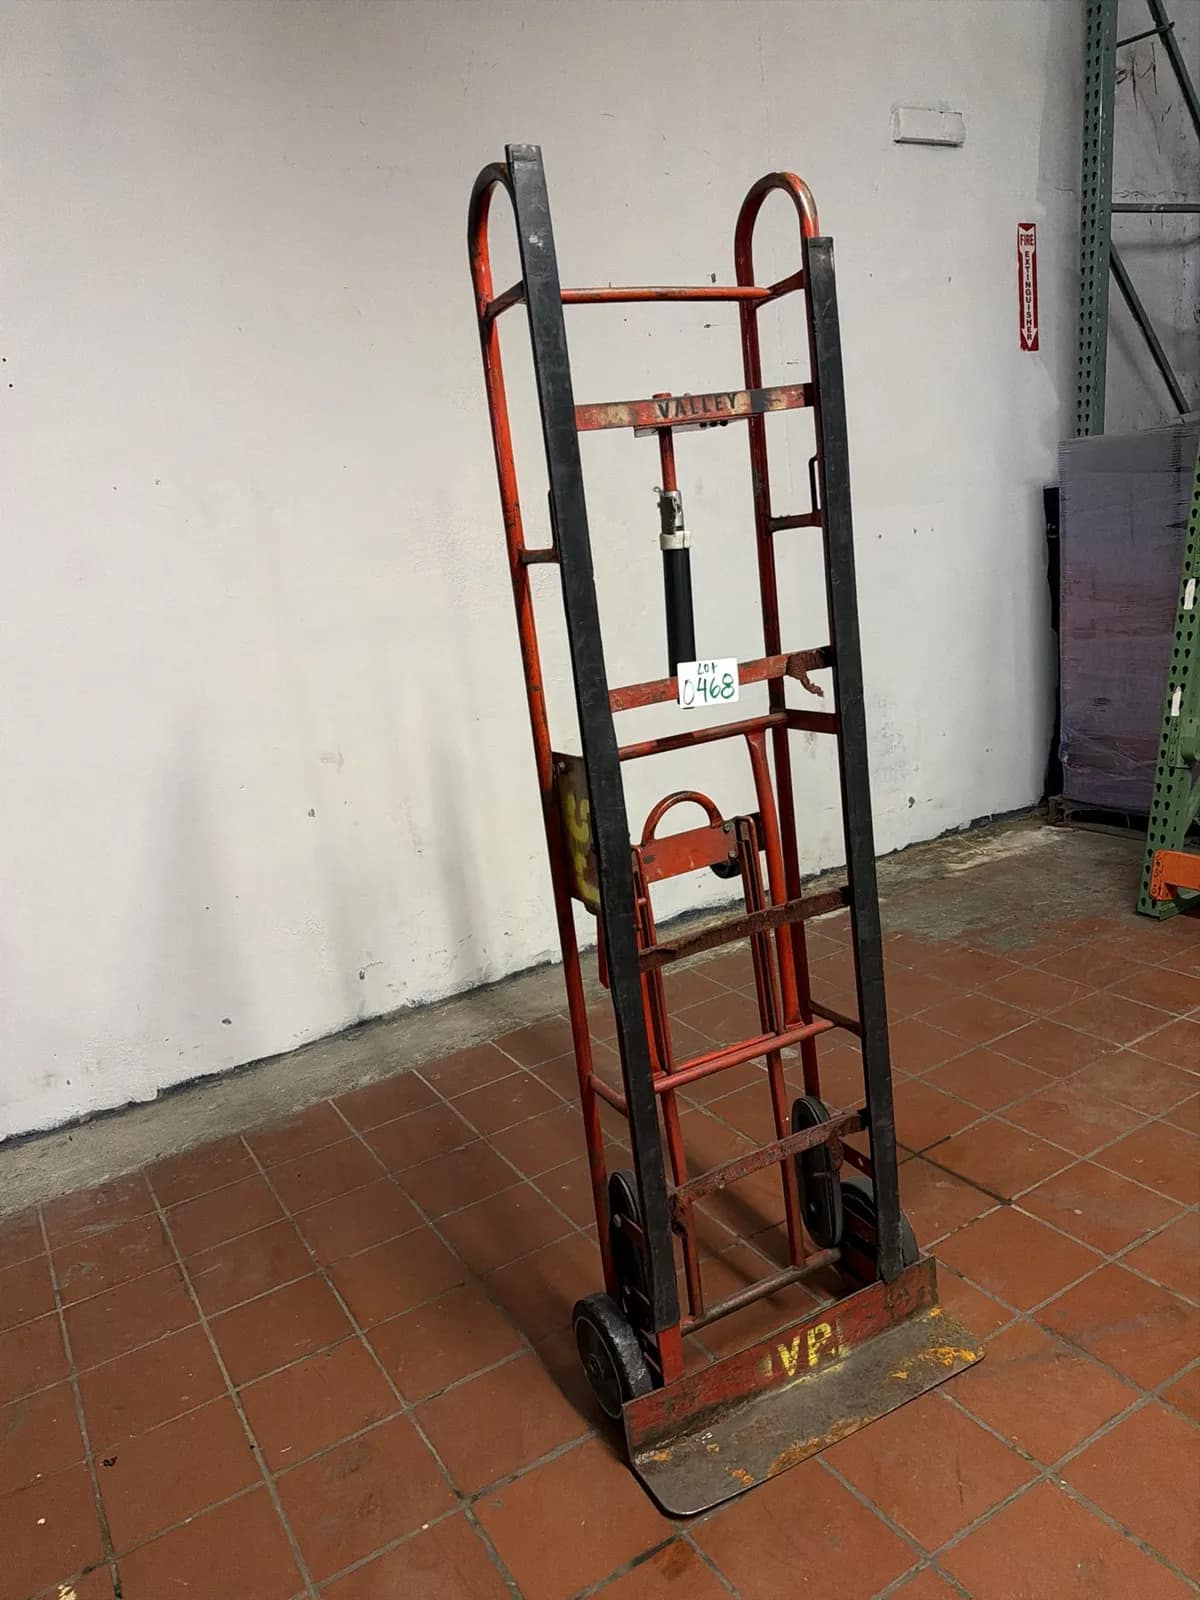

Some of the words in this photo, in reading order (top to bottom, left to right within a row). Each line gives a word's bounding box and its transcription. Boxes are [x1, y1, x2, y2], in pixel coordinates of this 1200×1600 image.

[1020, 234, 1033, 246] FIRE
[1024, 251, 1033, 340] EXTINGUISHER
[655, 392, 737, 418] VALLEY
[683, 673, 735, 705] 0468
